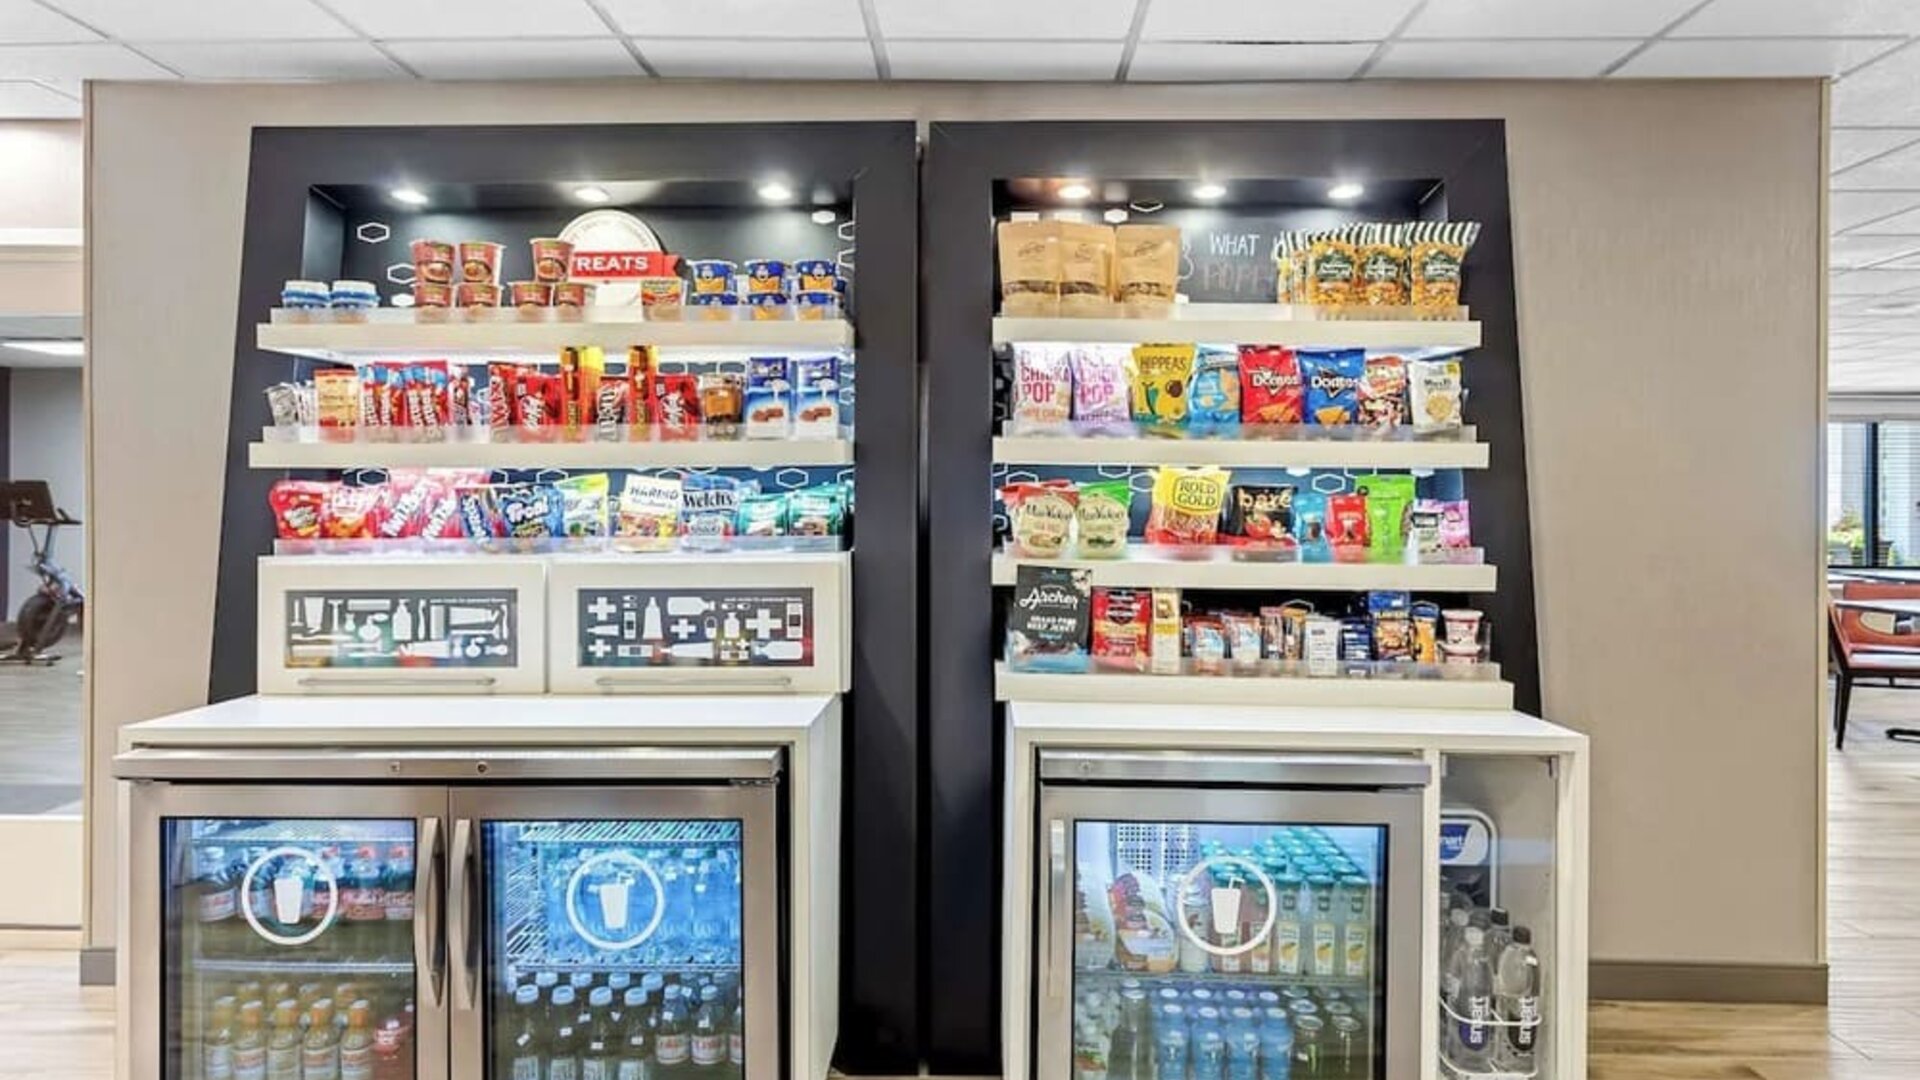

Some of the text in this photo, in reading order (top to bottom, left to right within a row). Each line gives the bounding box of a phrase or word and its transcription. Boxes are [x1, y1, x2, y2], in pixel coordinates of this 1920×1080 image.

[1209, 233, 1260, 256] WHAT
[572, 256, 649, 271] REATS
[1021, 382, 1055, 402] POP
[1177, 493, 1217, 507] GOLD
[1019, 588, 1078, 610] Archer
[1470, 996, 1489, 1043] smart
[1519, 996, 1537, 1043] smart
